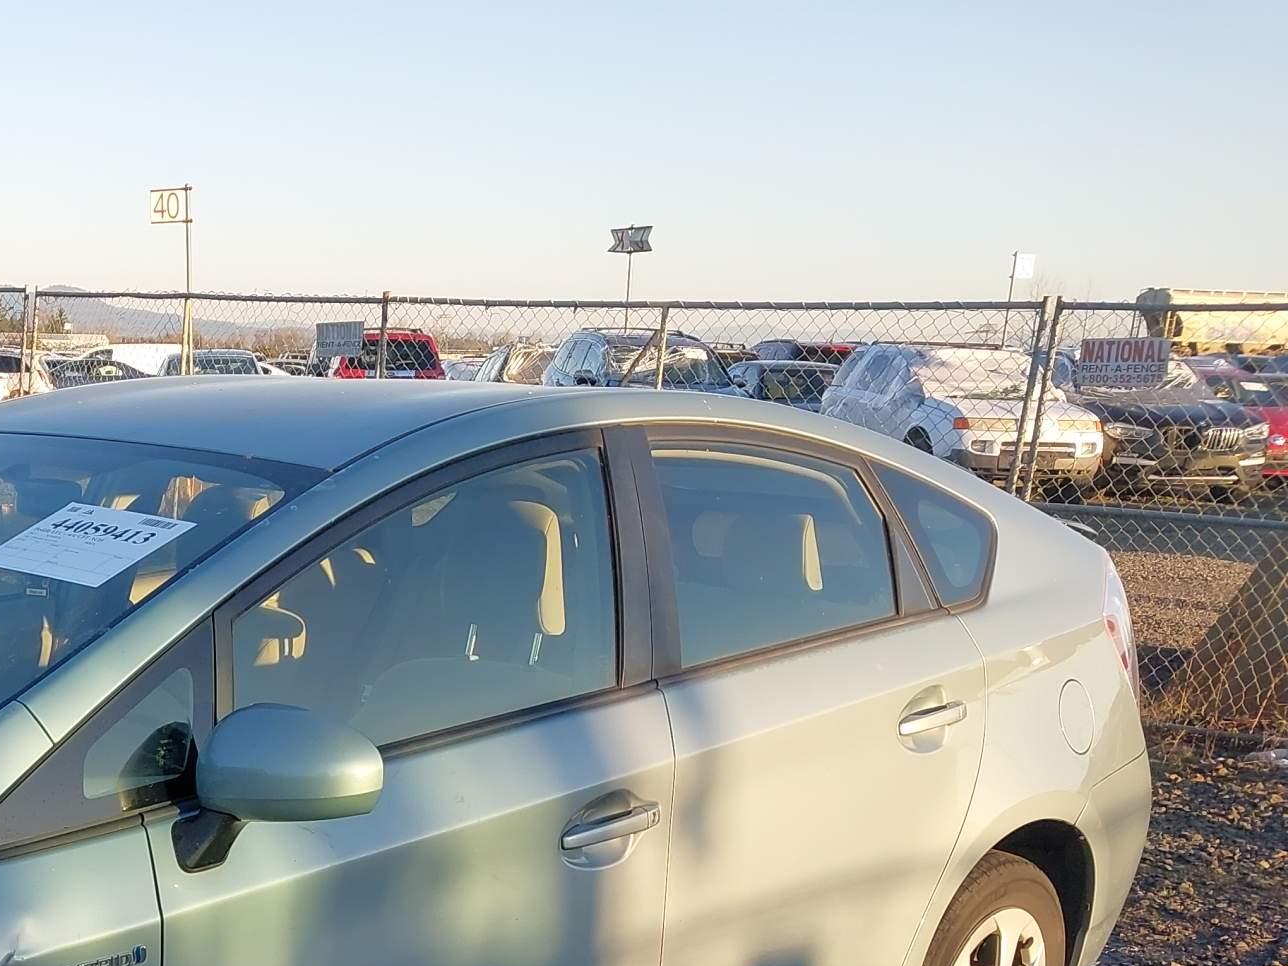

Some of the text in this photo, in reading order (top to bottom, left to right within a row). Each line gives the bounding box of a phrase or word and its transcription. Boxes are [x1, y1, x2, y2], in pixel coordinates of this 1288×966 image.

[153, 192, 180, 219] 40
[1081, 340, 1166, 363] NATIONAL
[1081, 363, 1165, 374] RENT-A-FENCE
[1081, 374, 1164, 384] 1-800-352-5675
[51, 518, 158, 545] 44059413
